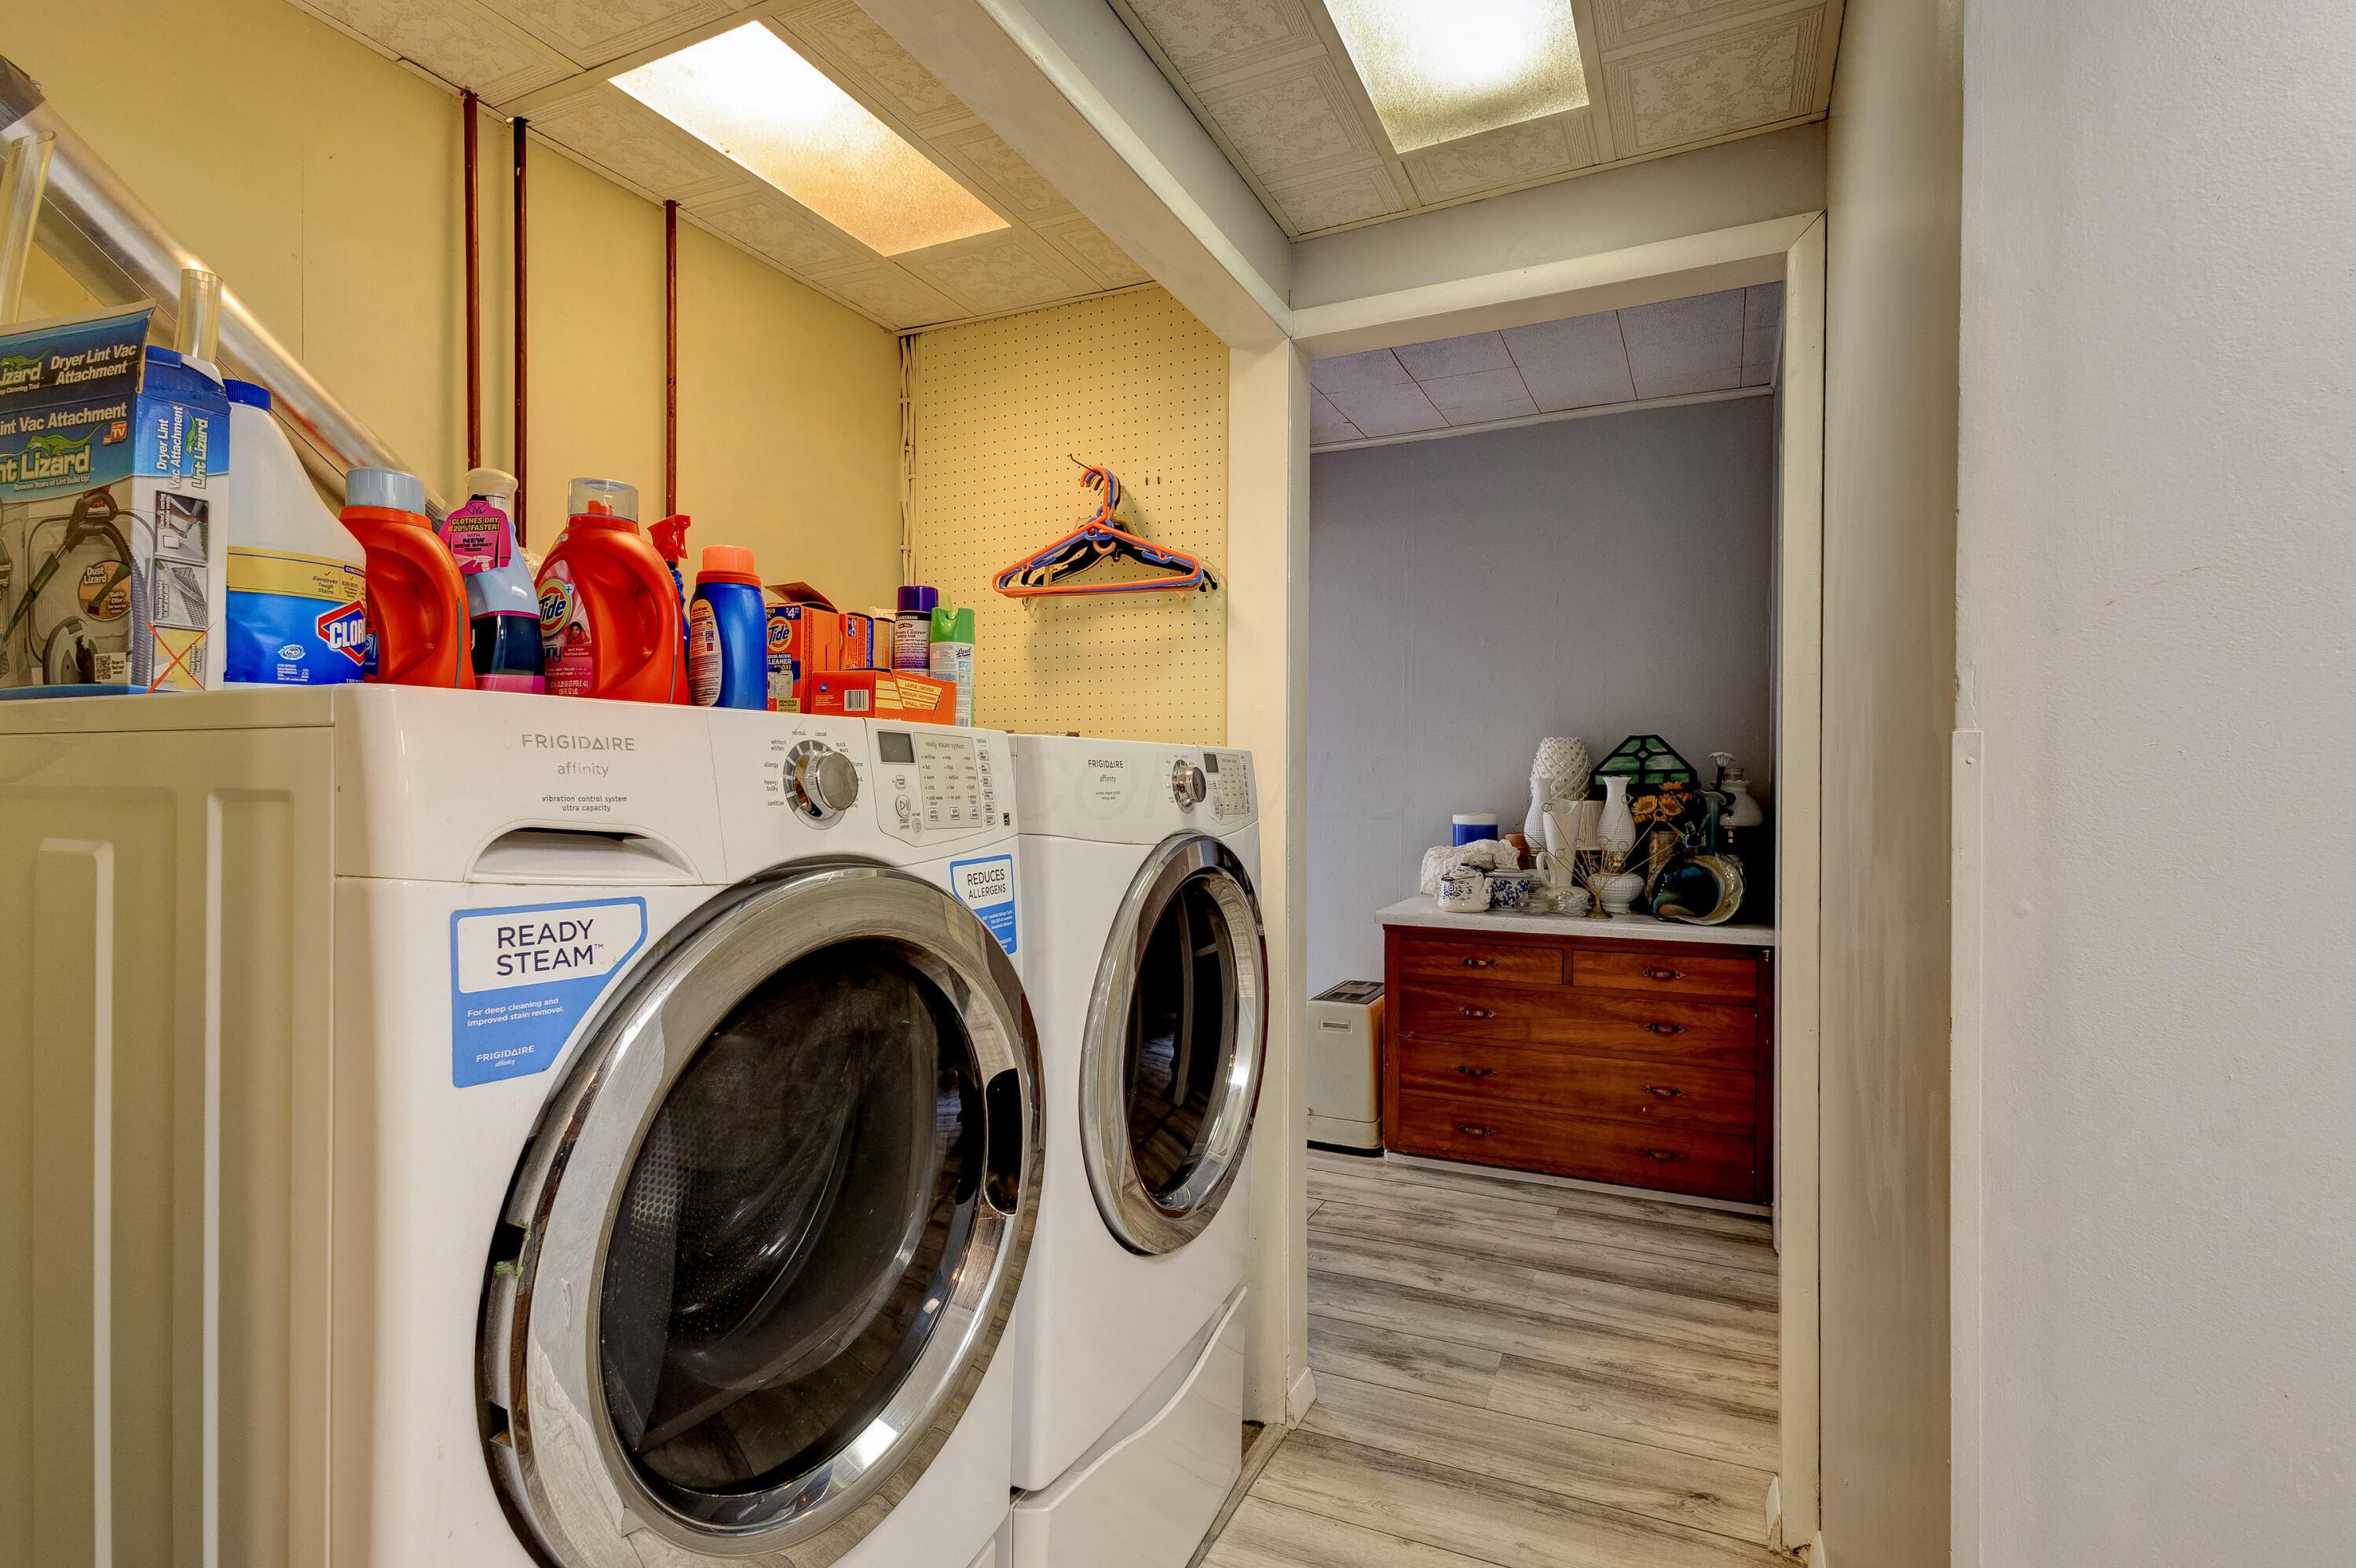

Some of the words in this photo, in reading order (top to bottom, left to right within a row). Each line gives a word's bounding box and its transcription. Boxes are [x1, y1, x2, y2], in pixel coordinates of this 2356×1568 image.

[50, 354, 85, 371] Dryer
[86, 347, 111, 364] Lint
[114, 344, 137, 358] Vac
[0, 362, 42, 385] izard
[55, 360, 127, 386] Attachment
[19, 416, 44, 432] Vac
[47, 402, 127, 429] Attachment
[157, 418, 169, 440] Lint
[170, 405, 183, 468] Attachment
[193, 417, 209, 461] Lizard
[20, 443, 92, 482] Lizard
[156, 440, 170, 470] Dryer
[170, 469, 181, 488] Vac
[192, 461, 207, 490] Lint
[83, 575, 107, 585] Lizard
[86, 565, 104, 576] Dust
[539, 594, 567, 623] Tide
[768, 623, 790, 645] Tide
[521, 734, 635, 751] FRIGIDAIRE
[558, 762, 609, 778] affinity
[1099, 774, 1116, 784] affinity
[605, 795, 627, 804] system
[967, 868, 1005, 886] REDUCES
[968, 883, 1007, 900] ALLERGENS
[497, 919, 594, 948] READY
[467, 1014, 507, 1027] improved
[510, 1011, 530, 1020] stain
[532, 1006, 565, 1016] removal.
[485, 1006, 506, 1014] deep
[508, 1000, 542, 1011] cleaning
[476, 1044, 535, 1062] FRIGIDAIRE
